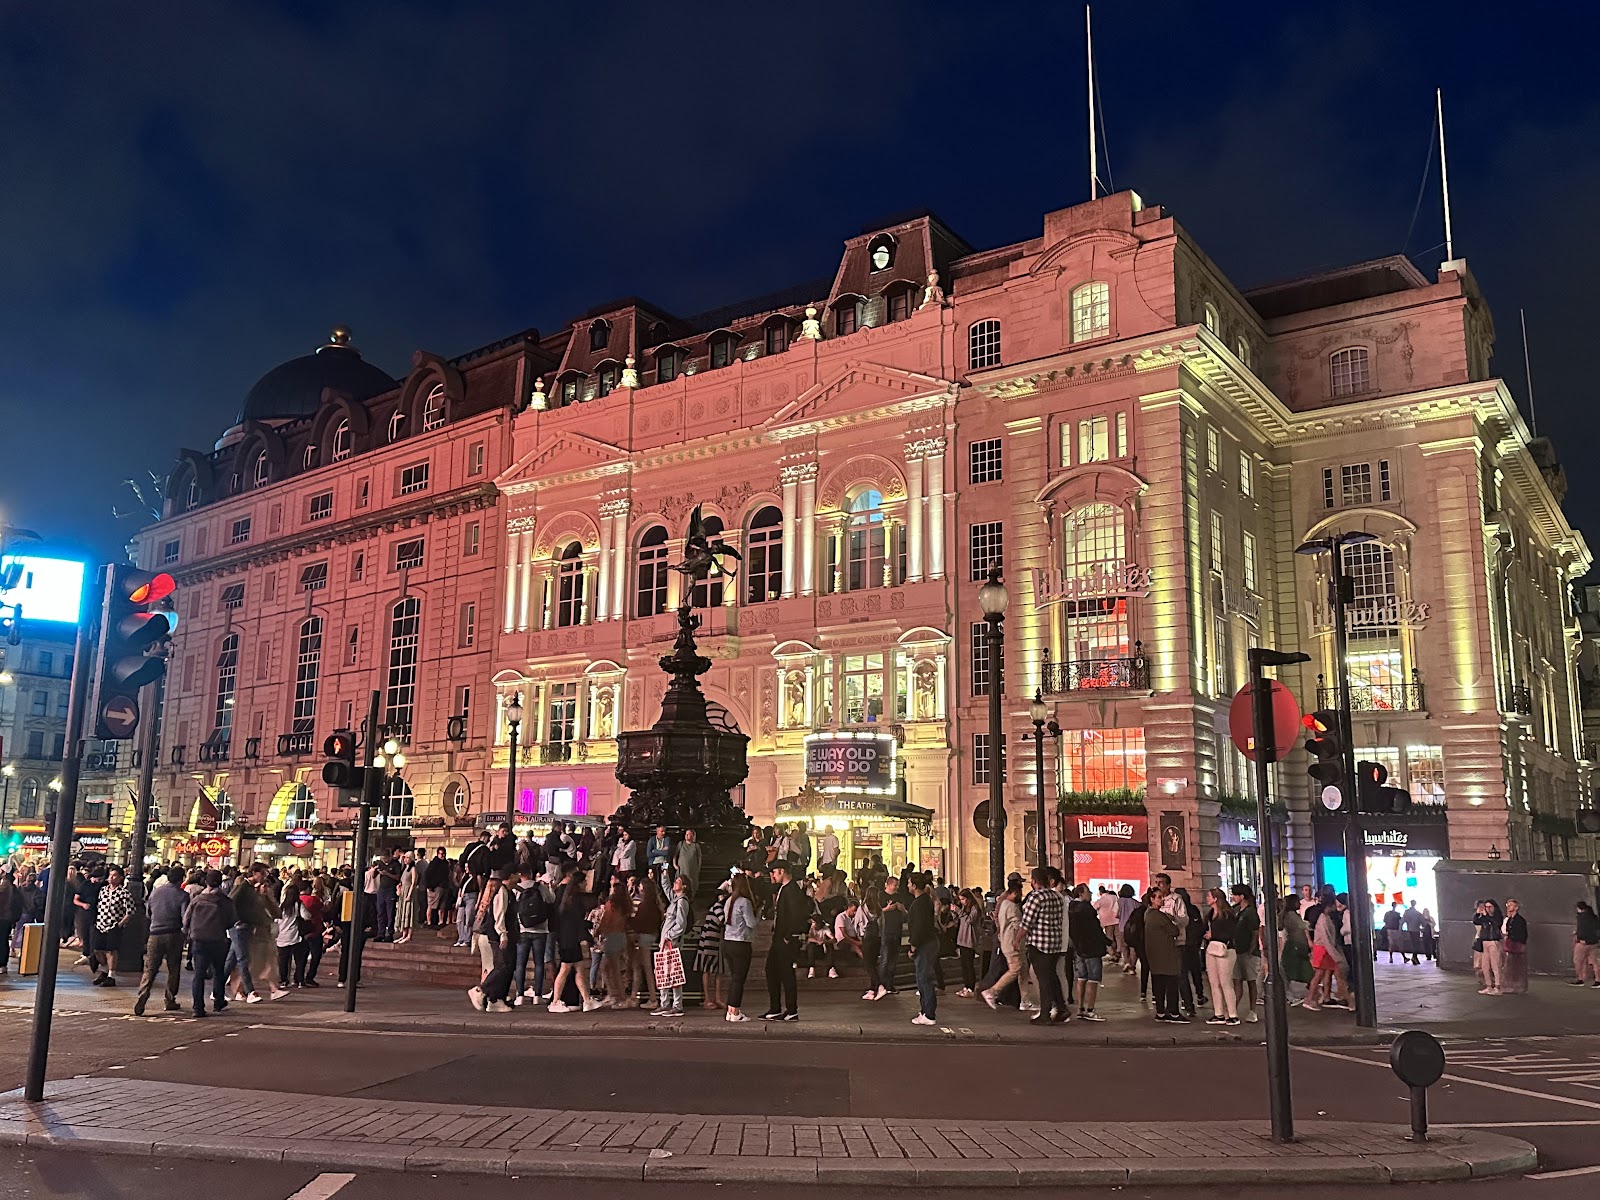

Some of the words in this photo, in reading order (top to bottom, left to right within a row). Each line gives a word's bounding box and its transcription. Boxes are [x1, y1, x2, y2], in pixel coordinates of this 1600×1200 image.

[1031, 560, 1151, 610] Lillywhites
[817, 748, 845, 760] WAY
[845, 747, 877, 760] OLD
[848, 760, 871, 773] DO
[838, 800, 877, 810] THEATRE
[514, 815, 555, 823] RESTAURANT
[1078, 818, 1134, 839] Lillywhites
[1363, 829, 1408, 847] lywhites
